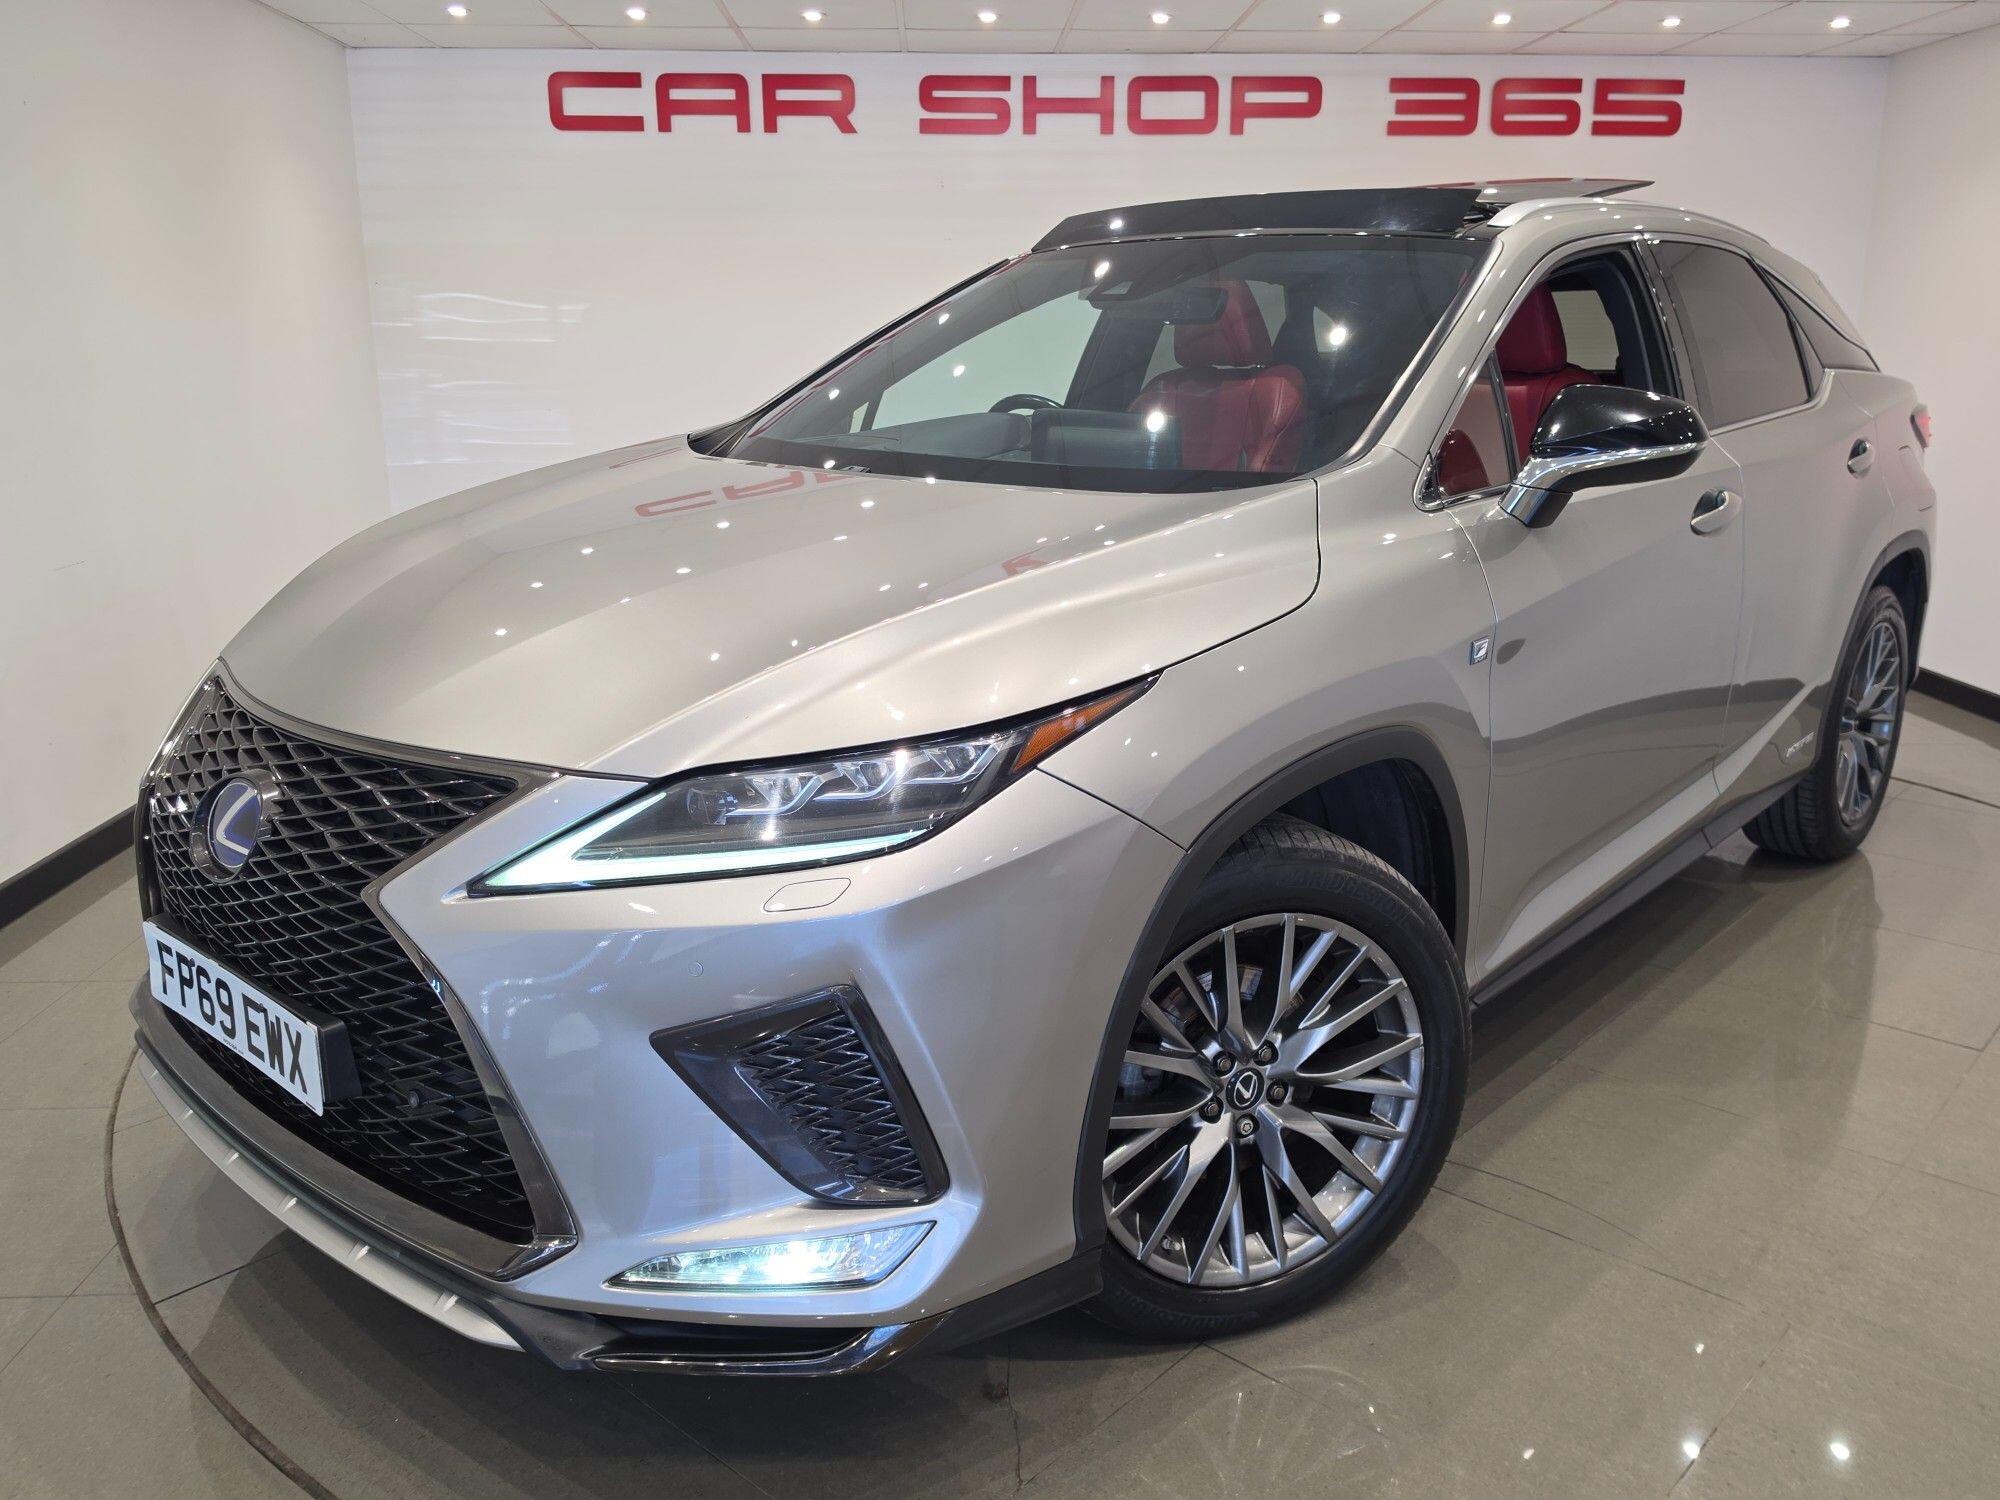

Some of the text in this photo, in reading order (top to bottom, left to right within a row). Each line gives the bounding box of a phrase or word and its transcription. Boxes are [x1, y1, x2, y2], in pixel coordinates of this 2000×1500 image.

[547, 71, 1686, 136] CAR SHOP 365
[156, 939, 308, 1095] FP69 EWX
